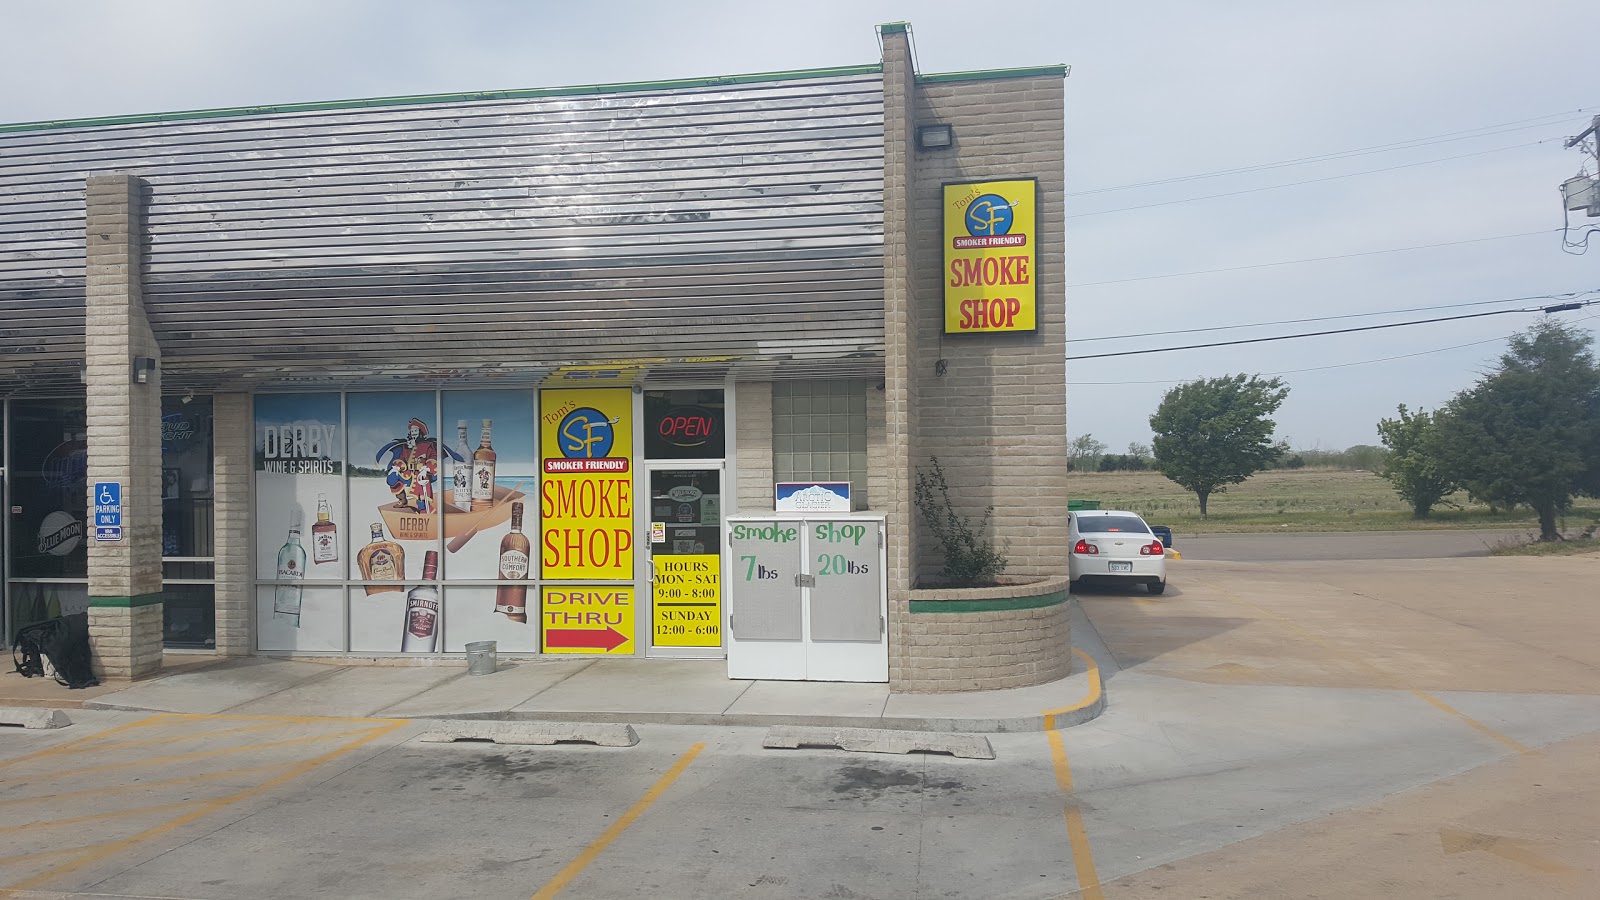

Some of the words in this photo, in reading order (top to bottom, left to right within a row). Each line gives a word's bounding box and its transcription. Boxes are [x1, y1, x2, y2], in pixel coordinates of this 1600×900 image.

[953, 188, 981, 210] Tom's
[970, 201, 1008, 235] SF
[956, 238, 987, 247] SMOKER
[989, 236, 1023, 245] FRIENDLY
[950, 255, 1029, 288] SMOKE
[960, 297, 1020, 329] SHOP
[543, 400, 576, 425] Tom's
[660, 416, 712, 436] OPEN
[264, 425, 336, 458] DERBY
[563, 416, 608, 458] SF
[264, 460, 287, 474] WINE
[290, 460, 296, 474] &
[298, 460, 333, 474] SPIRITS
[547, 461, 584, 470] SMOKER
[586, 461, 624, 470] FRIENDLY
[542, 479, 630, 519] SMOKE
[794, 492, 832, 502] ARCTIC
[96, 505, 120, 513] PARKING
[100, 515, 116, 524] ONLY
[400, 518, 430, 531] DERBY
[39, 533, 59, 553] BLUE
[60, 523, 80, 540] MOON
[544, 529, 632, 568] SHOP
[664, 562, 708, 572] HOURS
[654, 574, 684, 584] MON
[695, 574, 718, 584] SAT
[547, 592, 629, 605] DRIVE
[658, 588, 681, 598] 9:00
[692, 588, 715, 598] 8:00
[544, 612, 622, 624] THRU
[662, 611, 712, 621] SUNDAY
[656, 625, 685, 635] 12:00
[696, 625, 718, 635] 6:00
